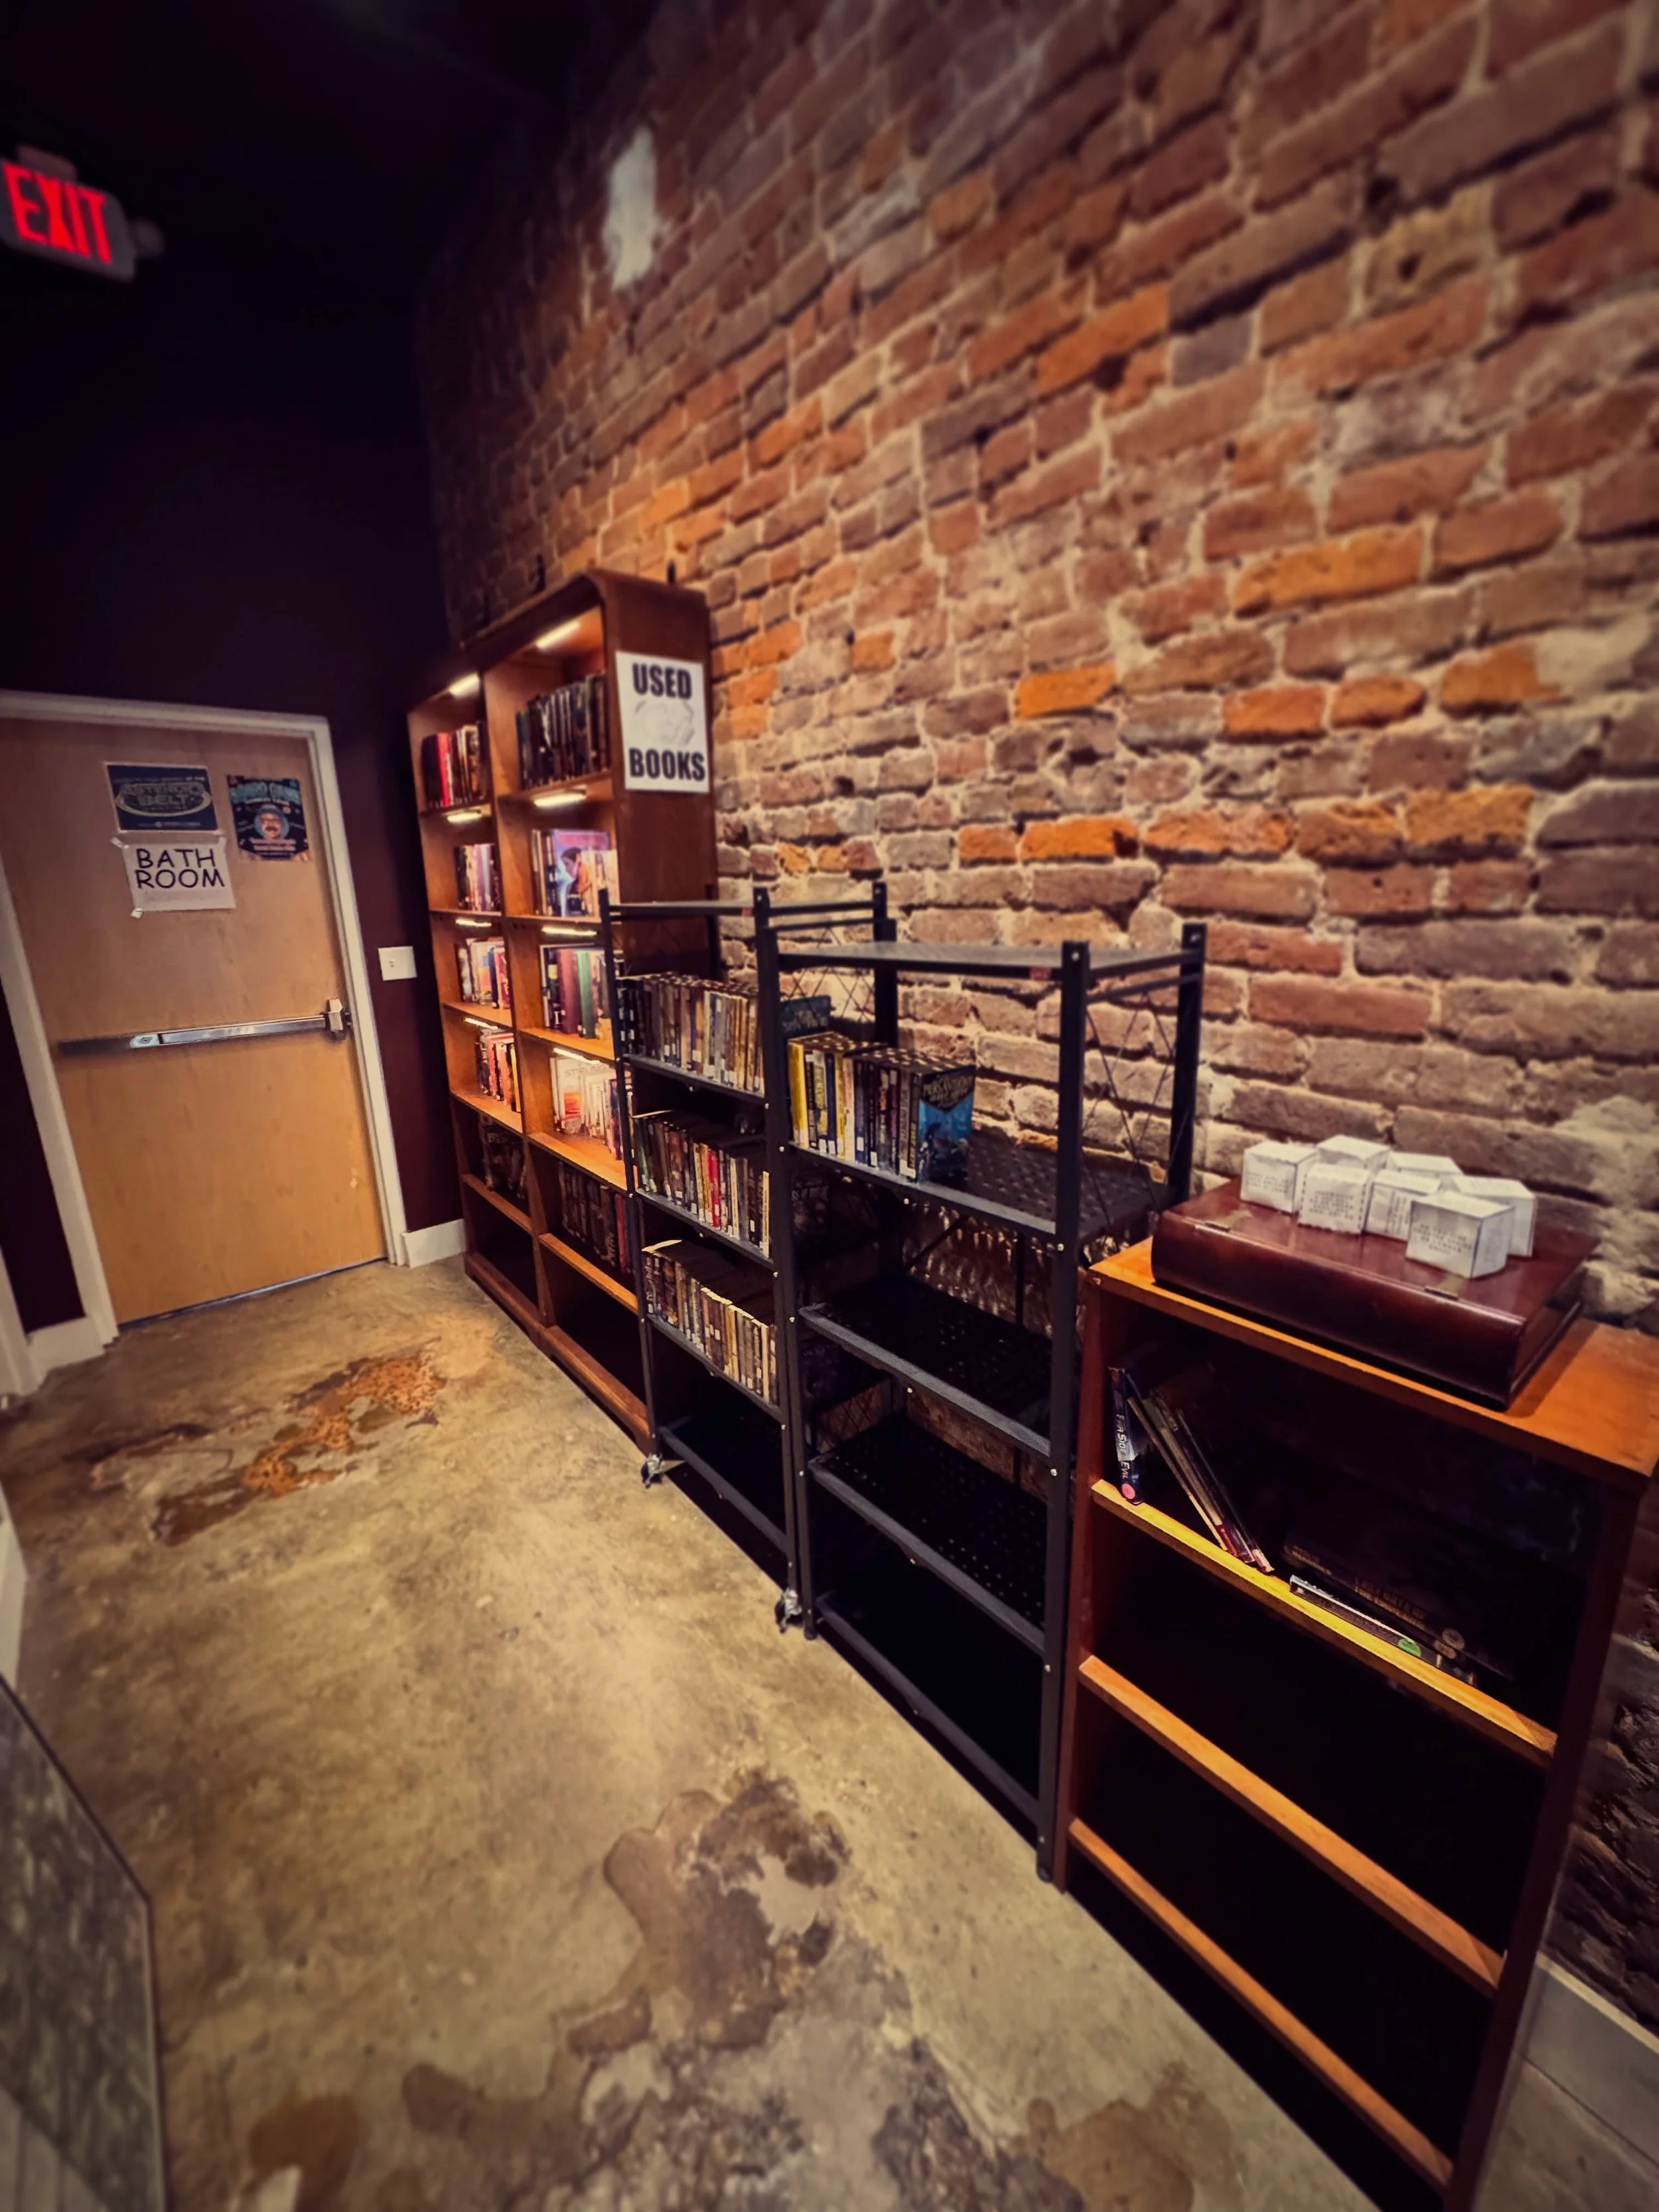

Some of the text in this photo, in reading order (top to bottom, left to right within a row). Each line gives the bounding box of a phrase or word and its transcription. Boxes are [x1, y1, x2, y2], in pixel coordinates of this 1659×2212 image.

[3, 161, 112, 264] EXIT
[632, 662, 692, 700] USED
[628, 747, 705, 782] BOOKS
[136, 848, 216, 869] BATH
[135, 868, 225, 889] ROOM
[1120, 1461, 1130, 1479] EVIL
